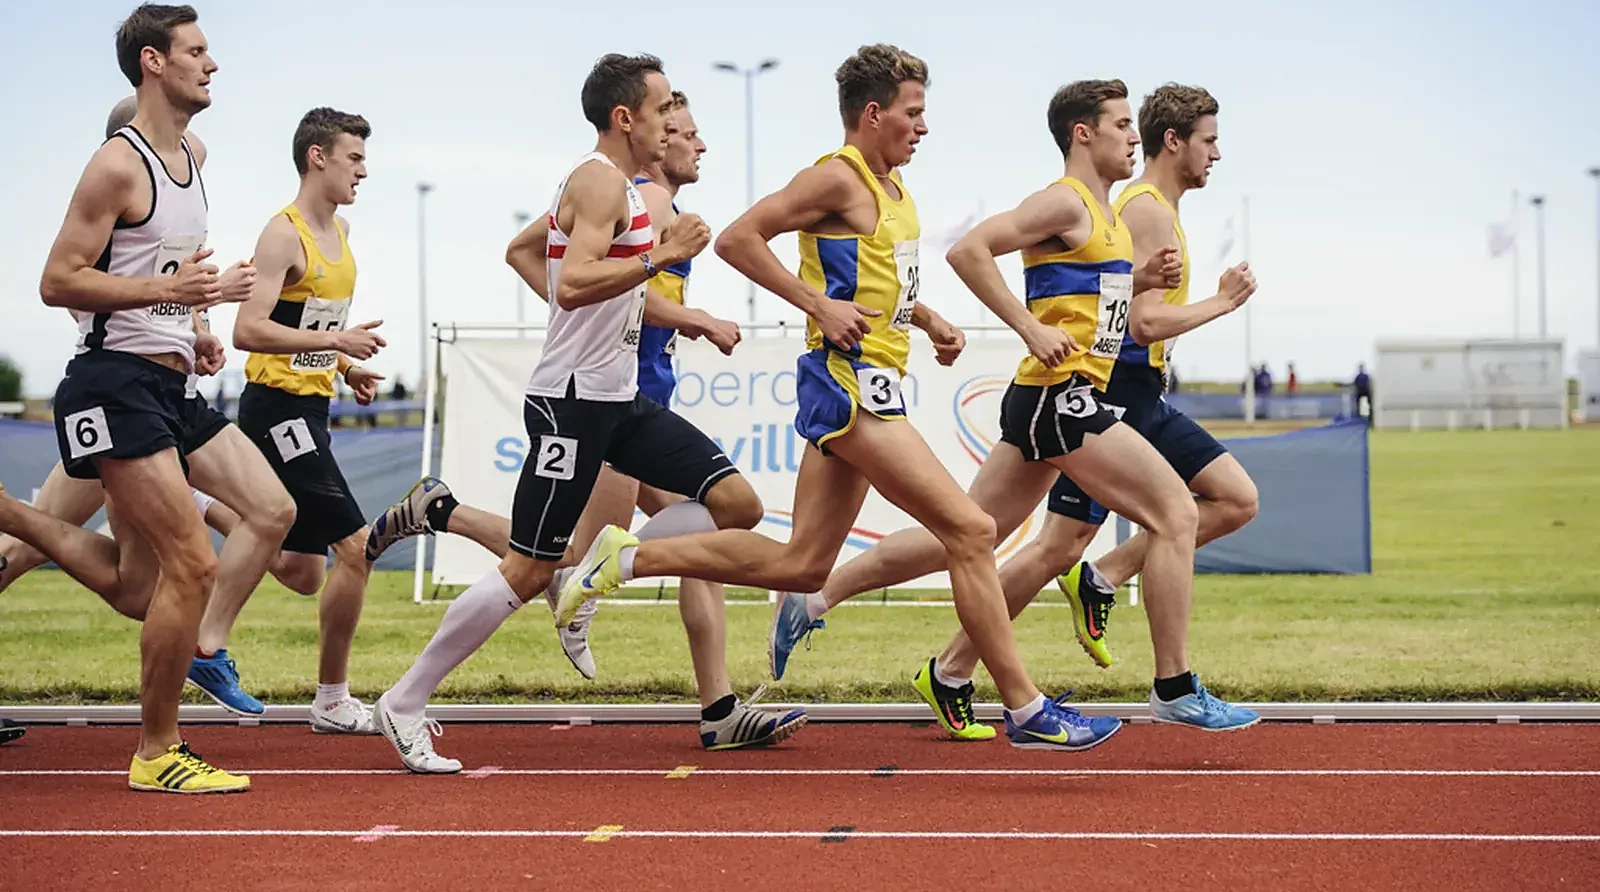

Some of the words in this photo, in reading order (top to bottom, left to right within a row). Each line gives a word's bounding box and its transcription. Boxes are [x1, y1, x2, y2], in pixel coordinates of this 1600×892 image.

[1106, 299, 1128, 333] 18
[870, 374, 892, 405] 3
[1065, 390, 1087, 414] 5
[75, 416, 98, 449] 6
[282, 425, 301, 450] 1
[543, 442, 567, 474] 2
